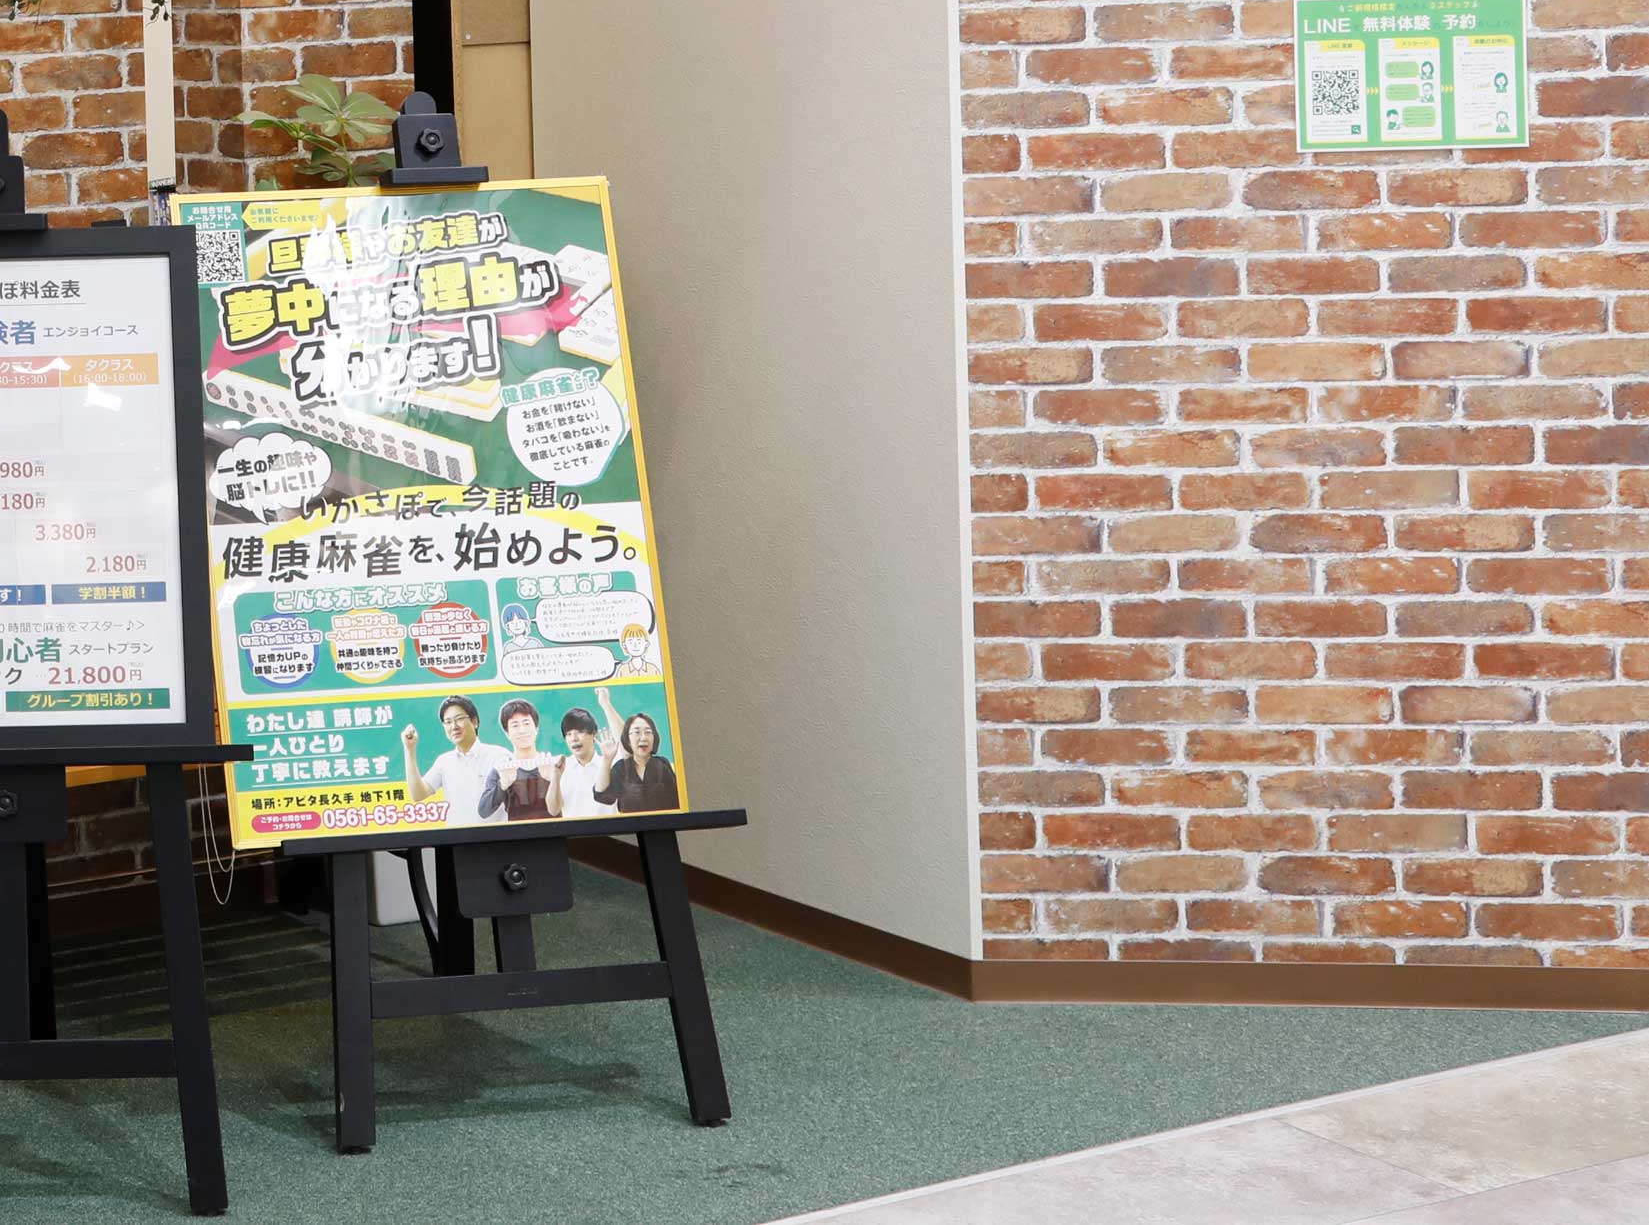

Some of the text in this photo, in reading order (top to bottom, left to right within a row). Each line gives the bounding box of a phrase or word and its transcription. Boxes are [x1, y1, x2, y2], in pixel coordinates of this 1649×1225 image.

[1303, 18, 1351, 34] LINE
[1362, 15, 1432, 32] 無料体験
[1442, 14, 1477, 31] 予約
[187, 213, 238, 222] メールアドレス
[42, 325, 139, 338] エンジョイコース
[223, 521, 638, 583] 健康麻雀を、始めよう。
[275, 583, 446, 611] こんな方にオススメ
[69, 642, 154, 655] スタートプラン
[253, 734, 345, 757] 一人ひとり
[252, 756, 390, 783] 丁寧に教えます
[323, 802, 450, 828] 0561-65-3337
